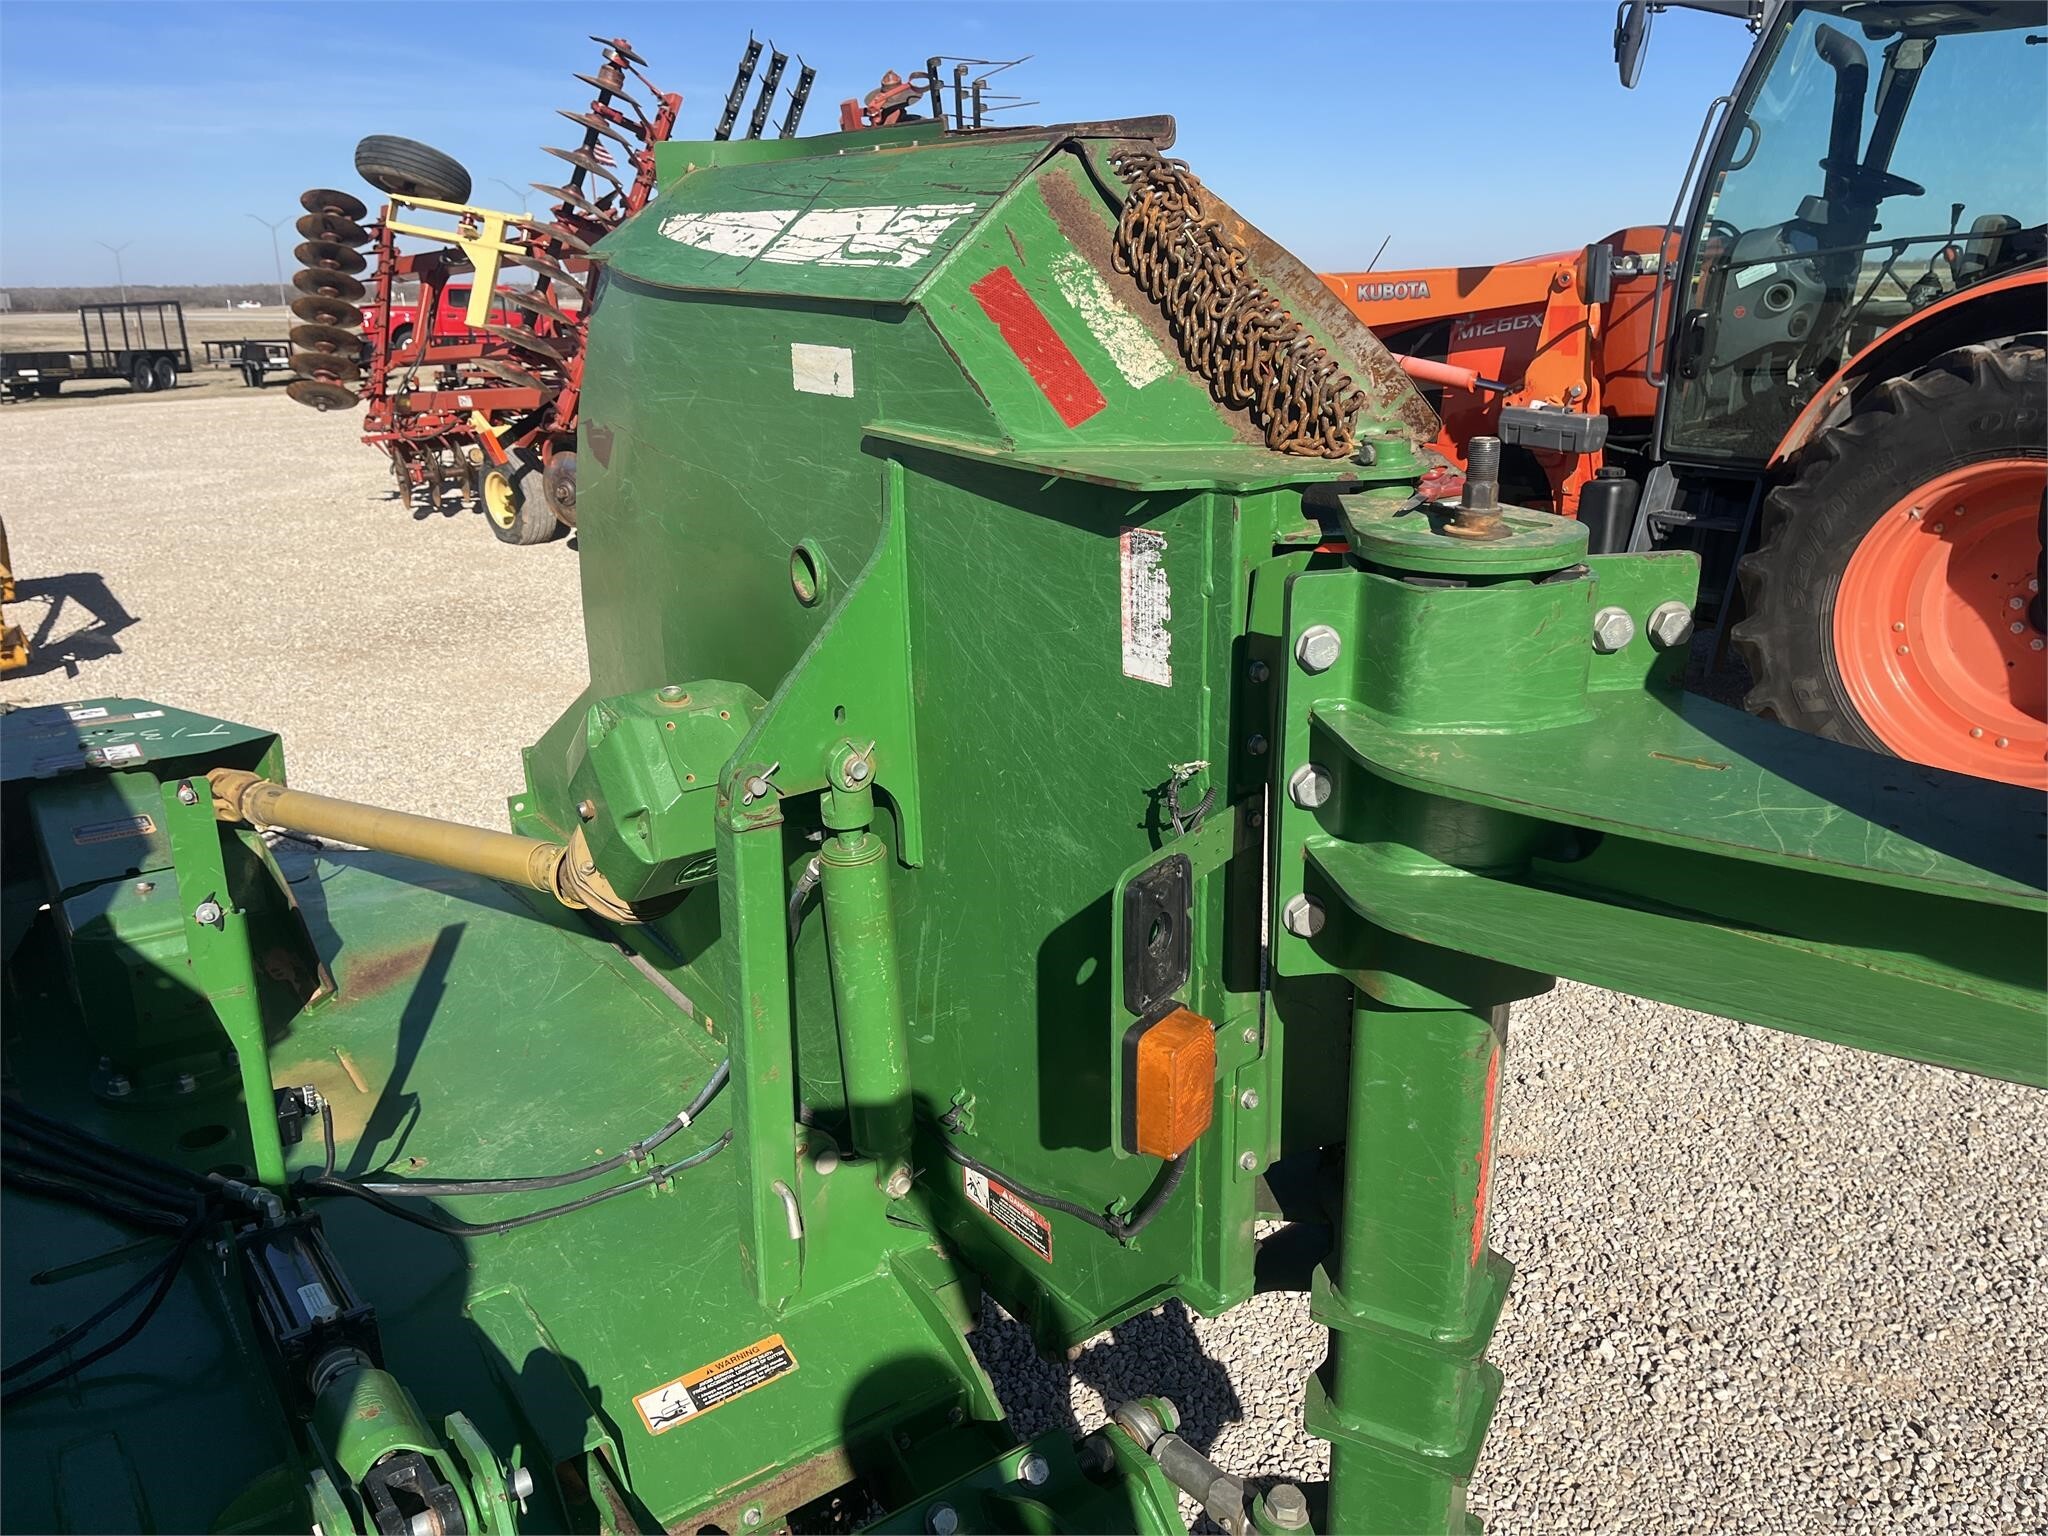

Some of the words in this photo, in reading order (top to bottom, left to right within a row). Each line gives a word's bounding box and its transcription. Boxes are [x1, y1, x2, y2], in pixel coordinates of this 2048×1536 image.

[1357, 280, 1430, 301] KUBOTA
[1457, 312, 1543, 340] M126GX
[715, 1345, 760, 1371] WARNING
